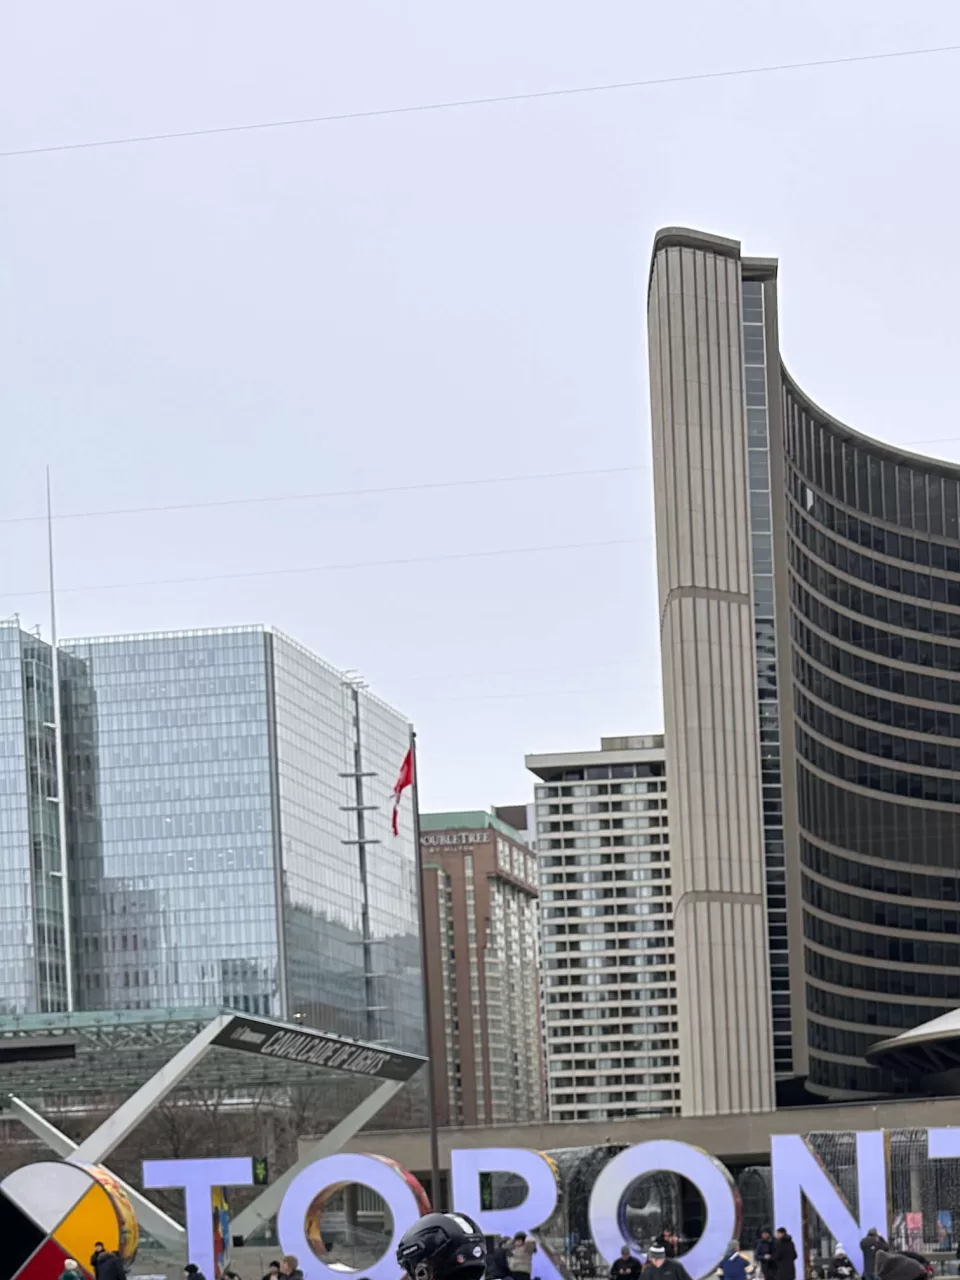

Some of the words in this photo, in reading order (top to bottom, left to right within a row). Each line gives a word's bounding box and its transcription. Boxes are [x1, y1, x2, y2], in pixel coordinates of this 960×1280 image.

[420, 832, 489, 846] OUBLETREE
[260, 1030, 341, 1065] CAVALCADE
[327, 1045, 357, 1067] OF
[342, 1047, 391, 1075] LIGHTS
